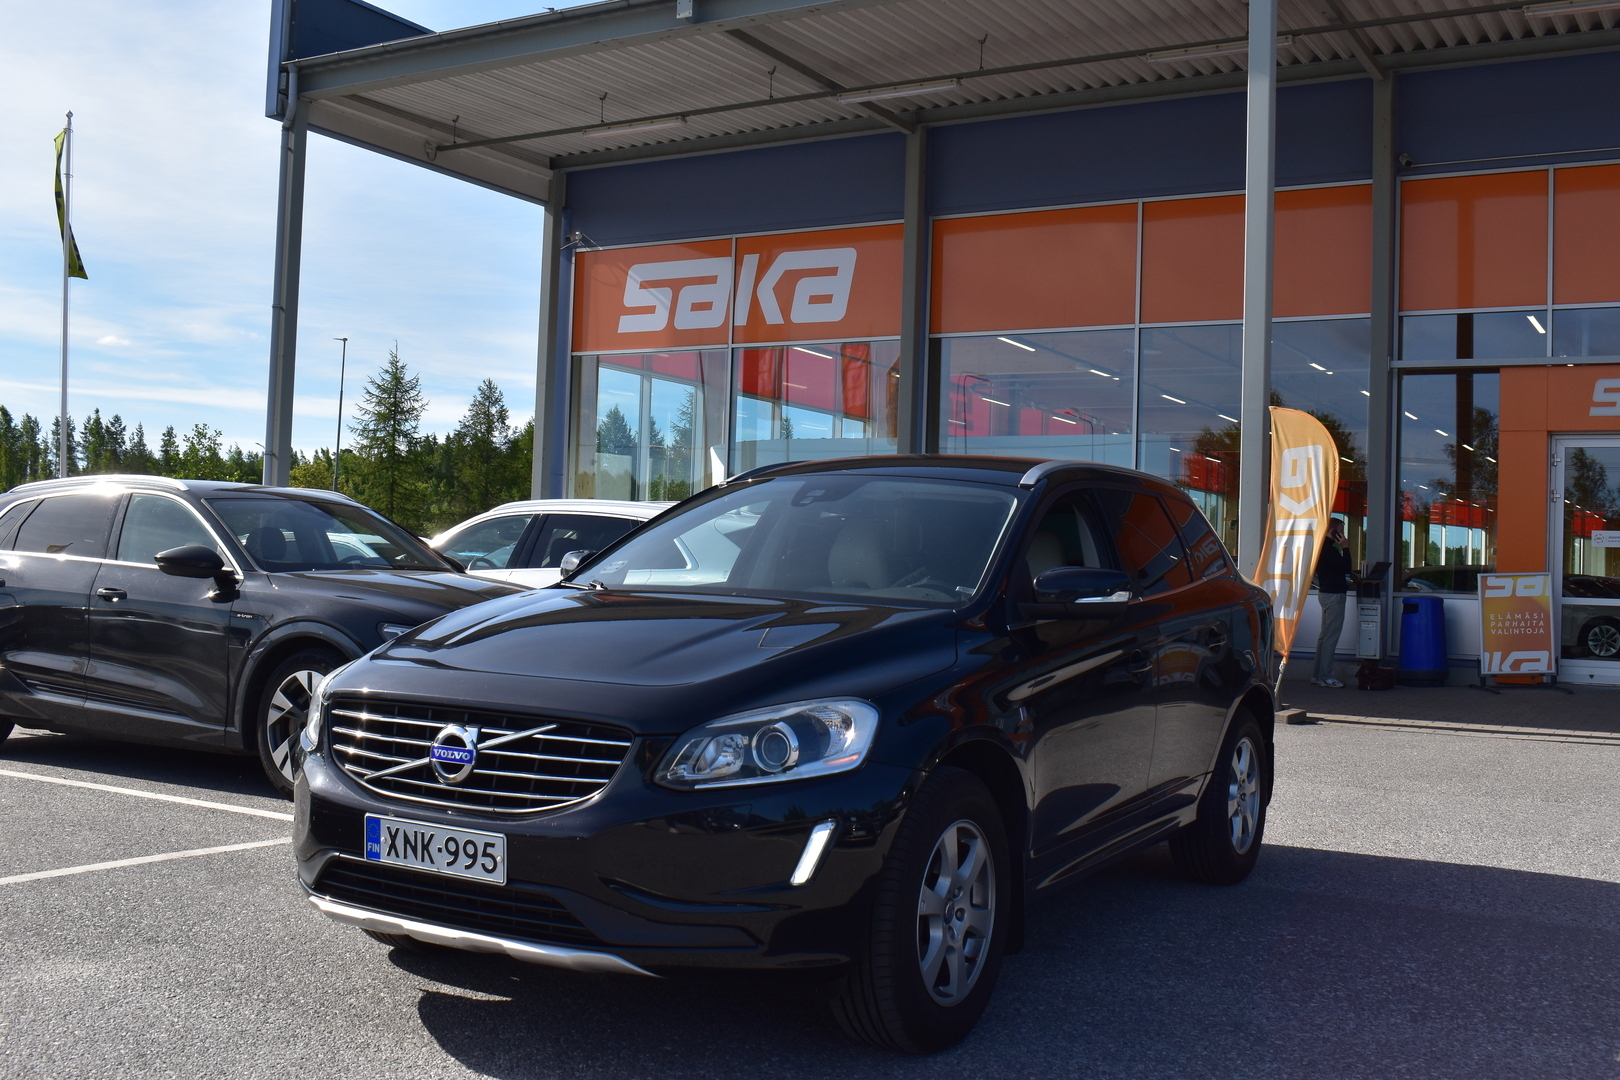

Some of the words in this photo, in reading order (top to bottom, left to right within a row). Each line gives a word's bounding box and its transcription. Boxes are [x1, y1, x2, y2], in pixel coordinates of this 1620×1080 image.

[1490, 612, 1544, 620] ELÄMÄSI
[433, 748, 471, 761] VOLVO
[367, 842, 380, 854] FIN
[386, 825, 498, 874] XNK-995
